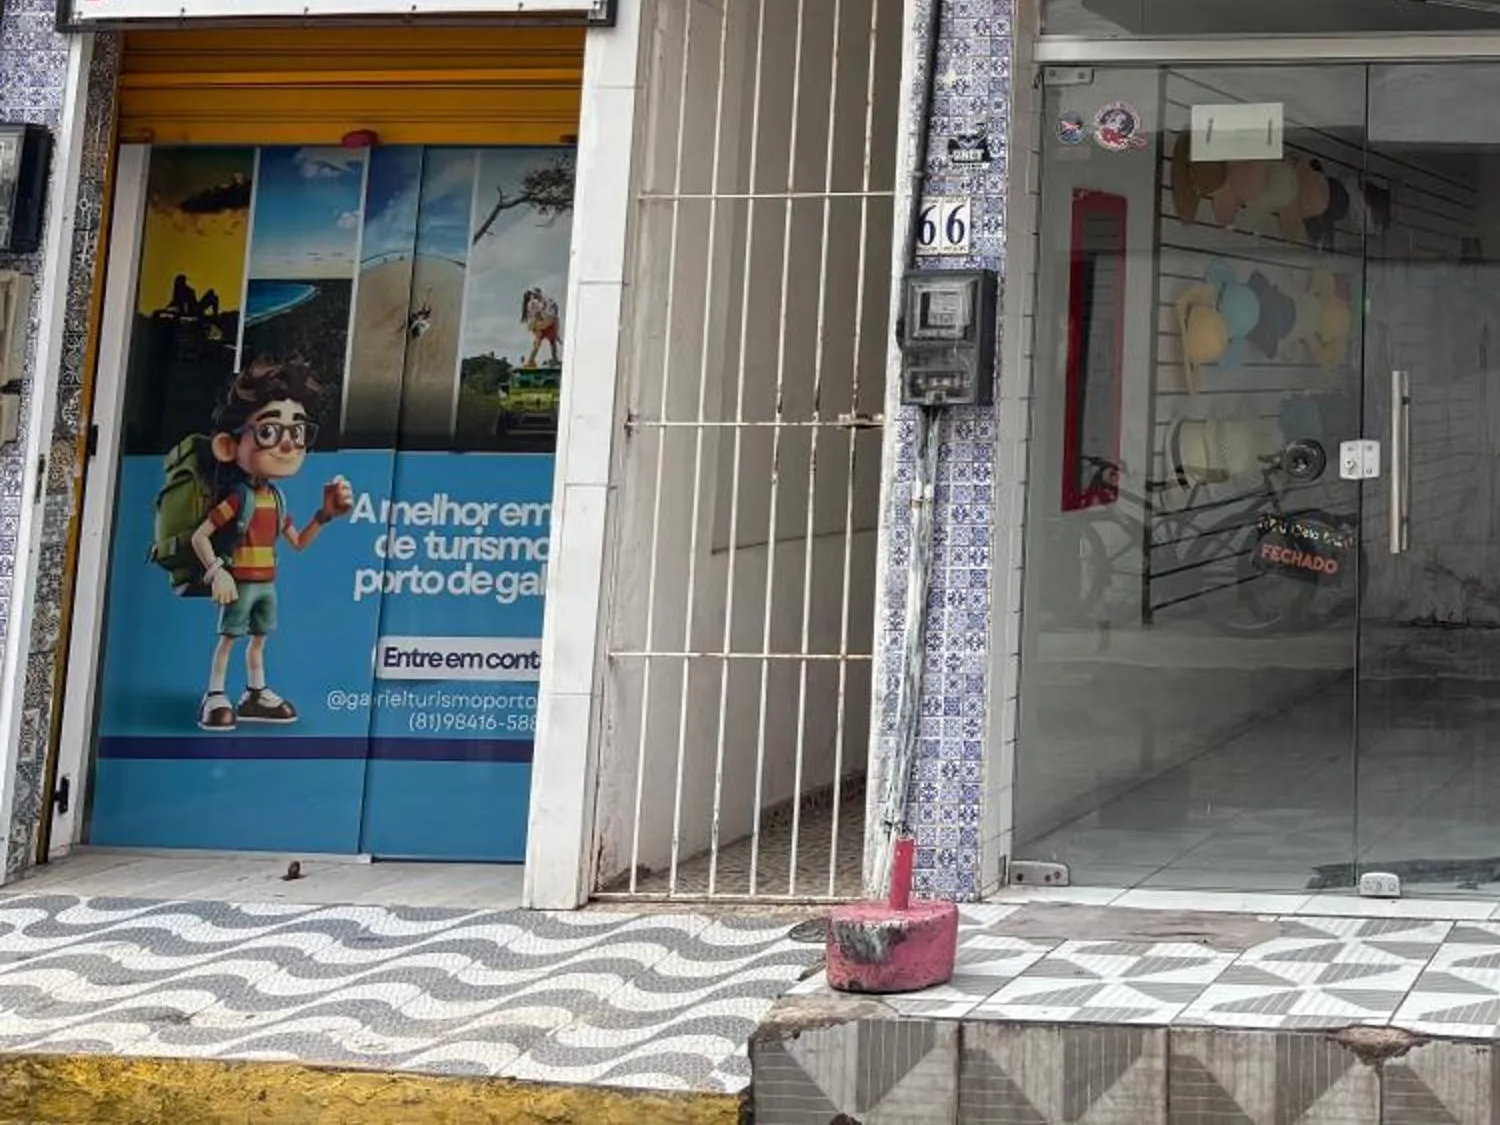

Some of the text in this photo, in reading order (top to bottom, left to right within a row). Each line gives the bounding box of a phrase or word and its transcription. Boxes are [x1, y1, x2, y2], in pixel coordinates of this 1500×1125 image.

[918, 205, 965, 245] 66
[349, 492, 377, 524] A
[380, 493, 497, 526] melhor
[374, 527, 417, 560] de
[1262, 544, 1339, 574] FECHADO
[353, 564, 445, 601] porto
[447, 562, 493, 594] de
[383, 647, 540, 669] Entre em cont
[327, 690, 537, 712] @garielturismoporto
